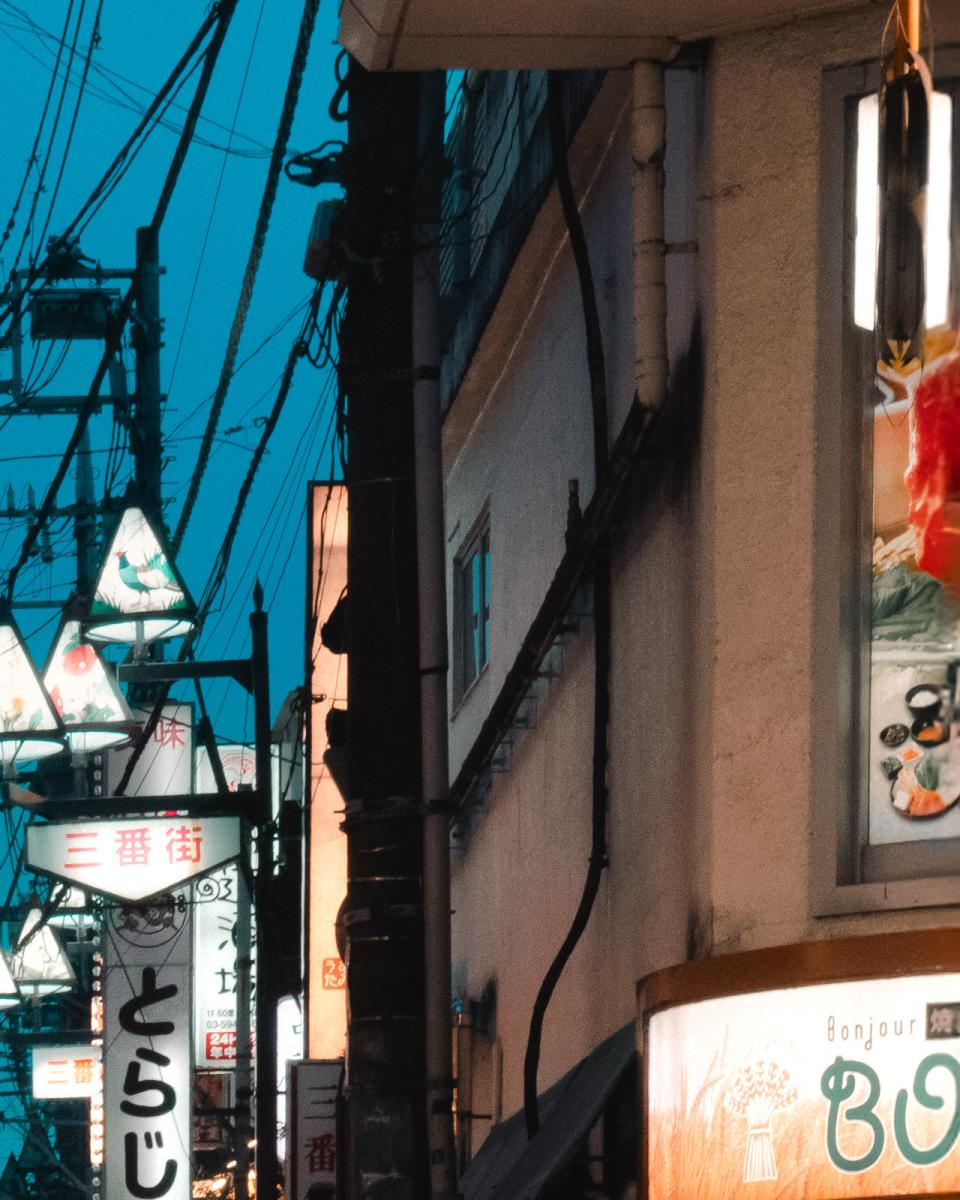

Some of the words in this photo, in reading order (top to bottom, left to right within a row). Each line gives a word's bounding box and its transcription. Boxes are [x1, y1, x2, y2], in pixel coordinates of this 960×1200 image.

[64, 825, 203, 869] 三番街
[827, 1015, 917, 1051] Bonjour
[119, 966, 178, 1200] とらじ
